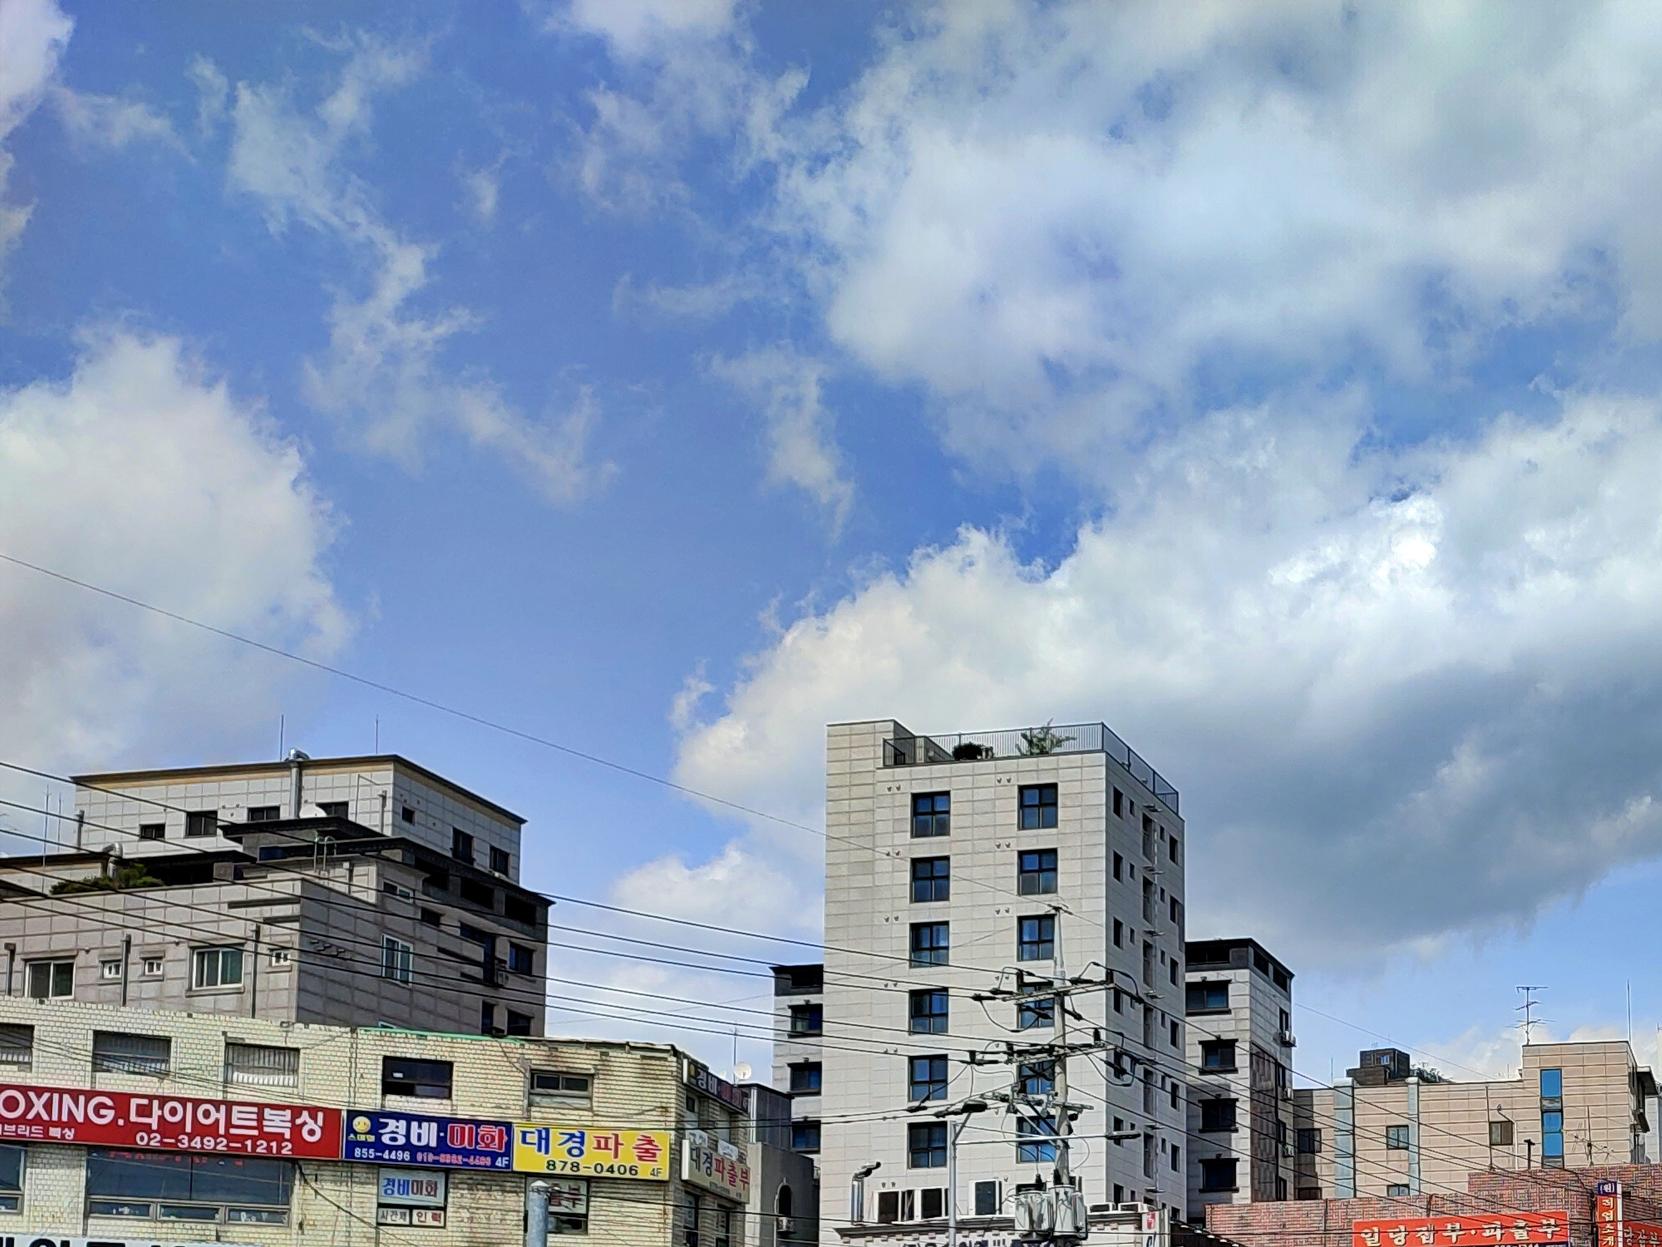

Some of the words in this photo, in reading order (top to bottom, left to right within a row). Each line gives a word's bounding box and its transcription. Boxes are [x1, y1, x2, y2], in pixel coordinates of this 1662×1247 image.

[136, 1131, 293, 1155] 02-3492-1212
[354, 1147, 411, 1162] 855-4496
[545, 1159, 639, 1177] 878-0406
[649, 1168, 663, 1178] 4F
